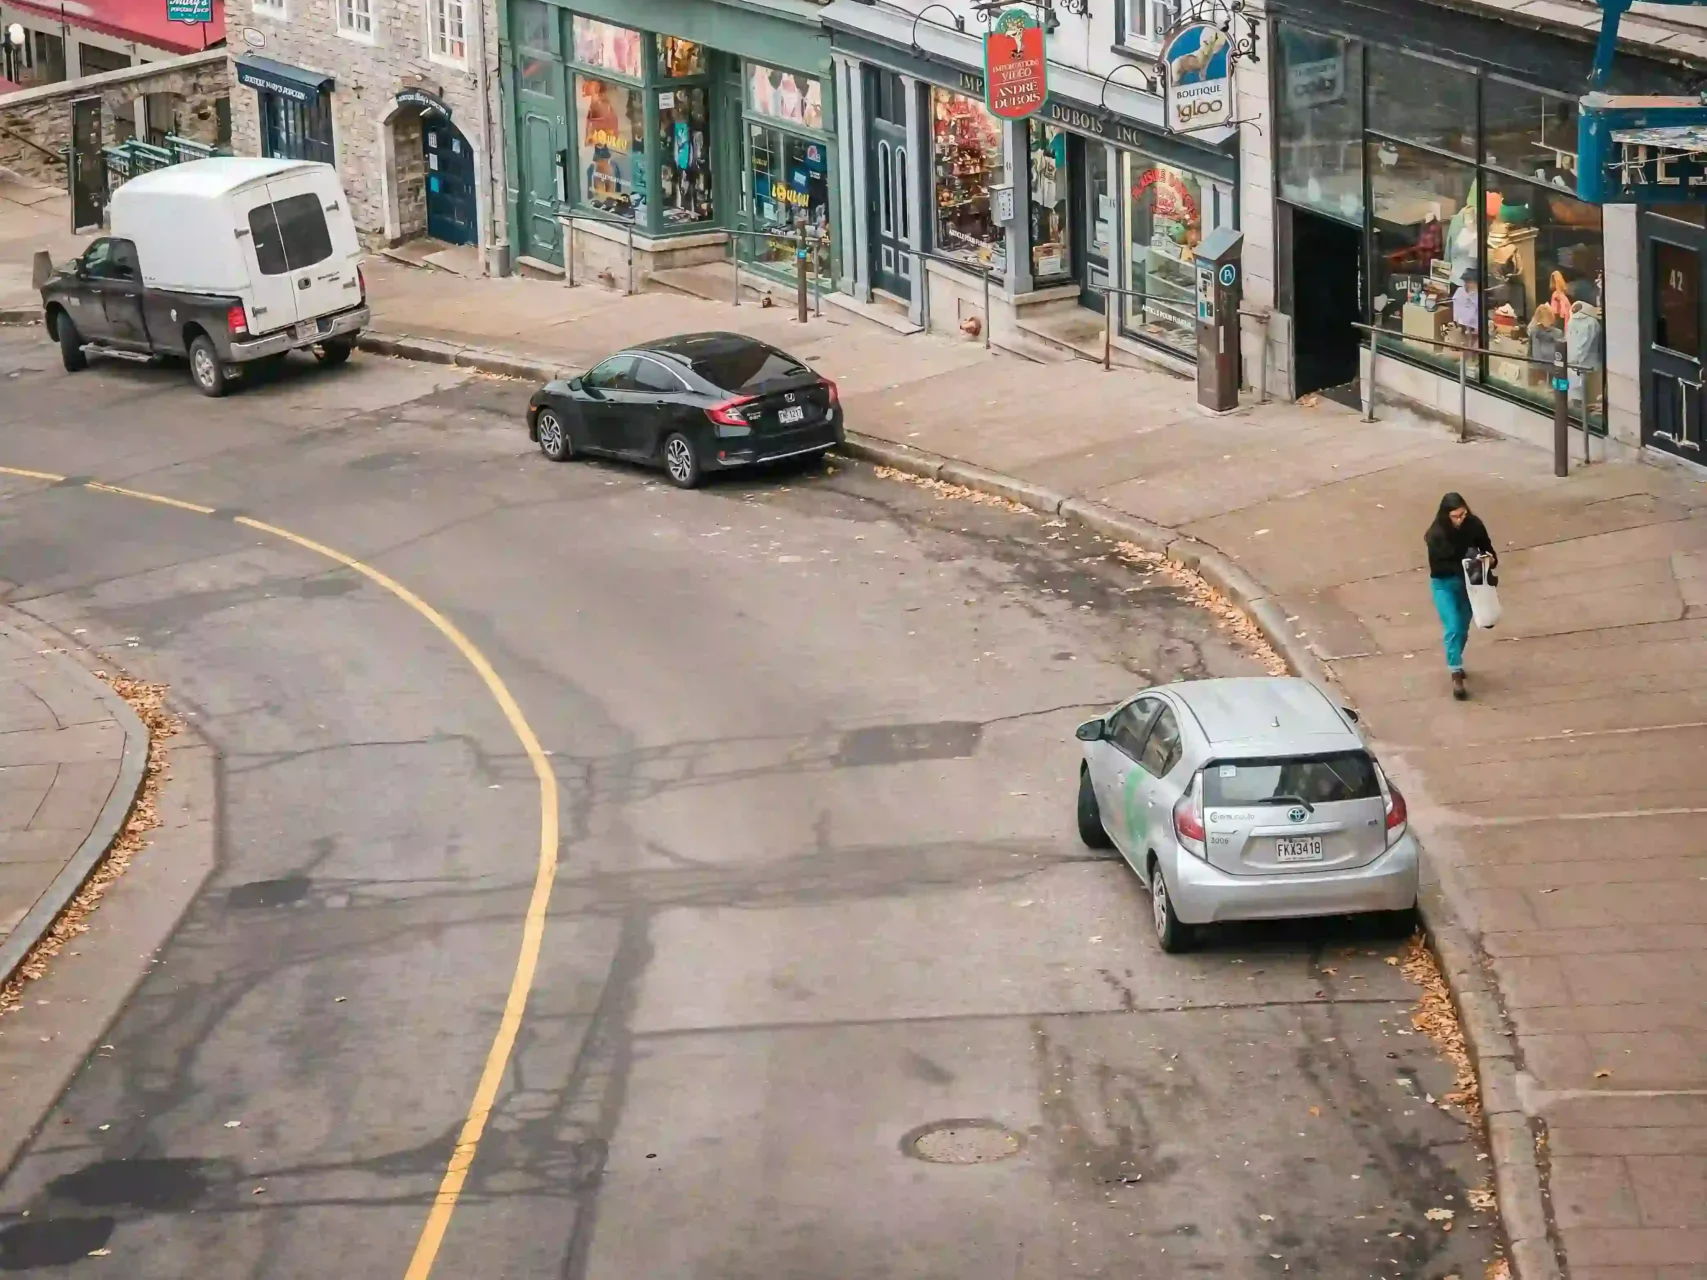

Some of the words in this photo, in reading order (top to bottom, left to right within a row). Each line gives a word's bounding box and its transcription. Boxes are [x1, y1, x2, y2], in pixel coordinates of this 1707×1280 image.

[1176, 84, 1221, 99] BOUTIQUE
[994, 93, 1041, 109] DUBOIS
[556, 115, 565, 125] 52
[1052, 104, 1103, 133] DUBOIS
[1669, 269, 1684, 292] 42
[1277, 841, 1321, 857] FKX3418
